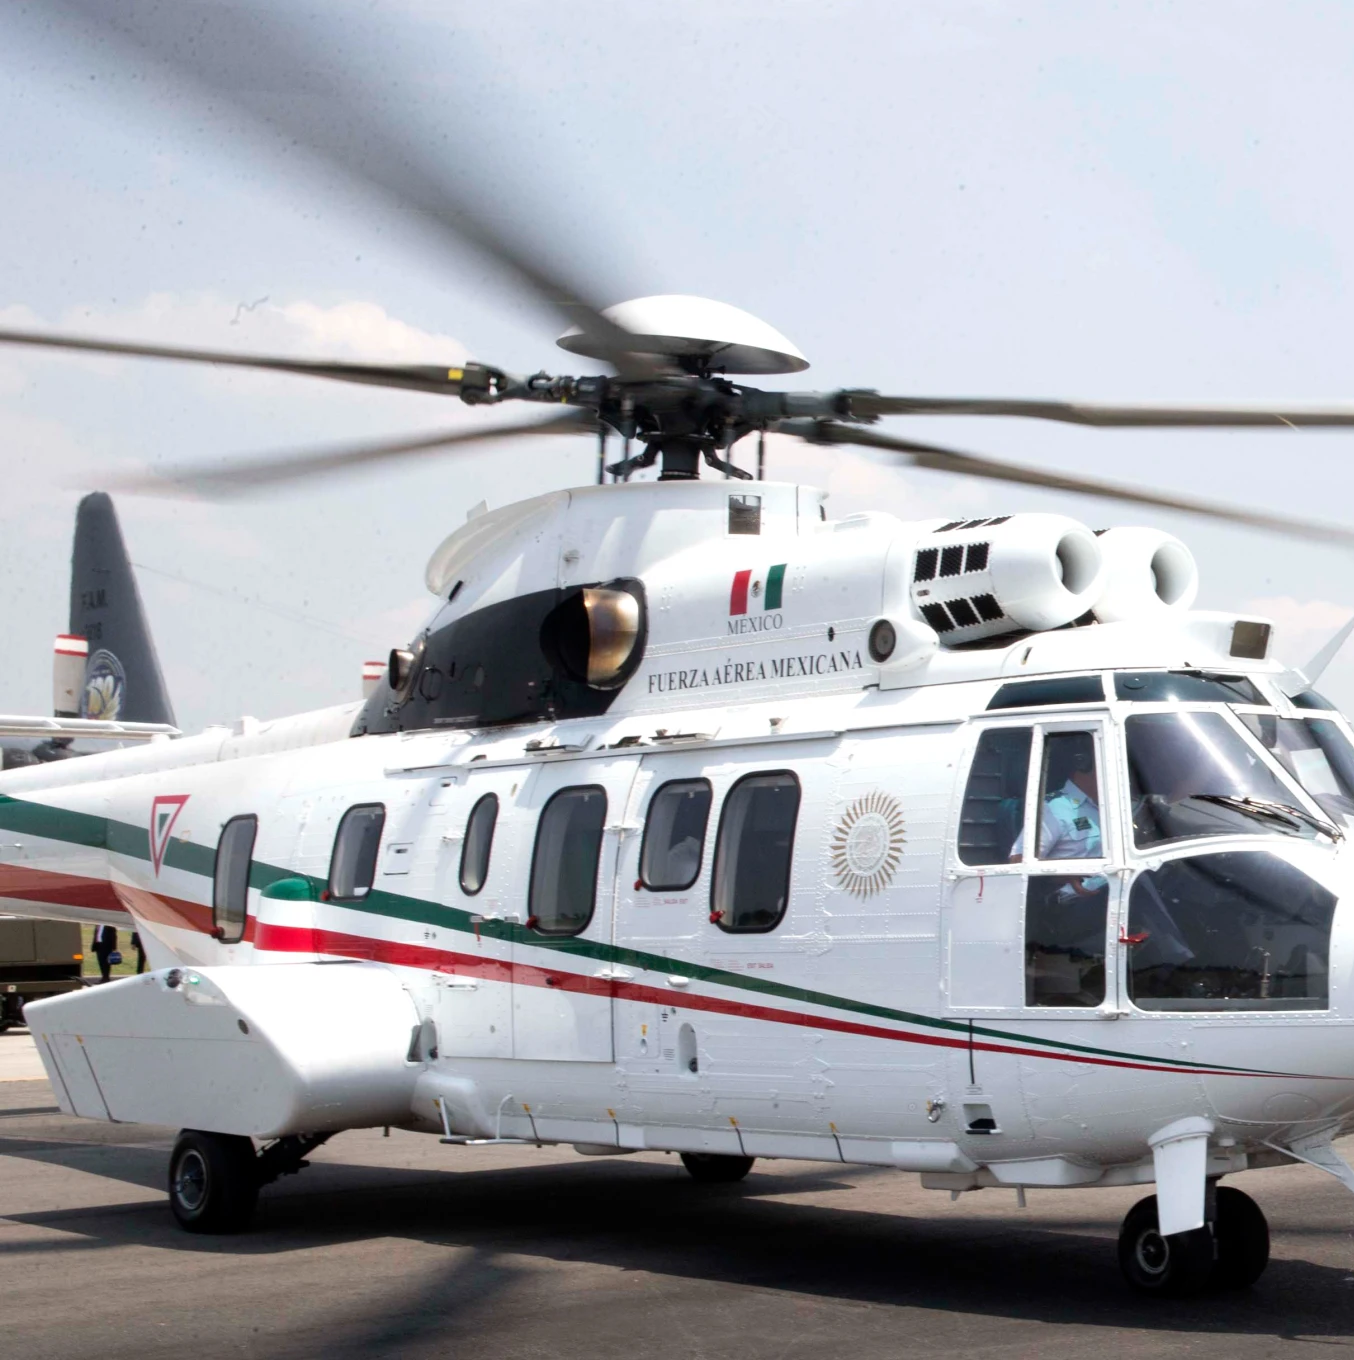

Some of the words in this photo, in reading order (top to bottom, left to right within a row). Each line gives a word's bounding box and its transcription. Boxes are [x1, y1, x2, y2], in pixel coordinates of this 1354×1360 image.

[648, 669, 709, 694] FUERZA
[711, 658, 766, 686] AÉREA
[770, 650, 863, 680] MEXICANA
